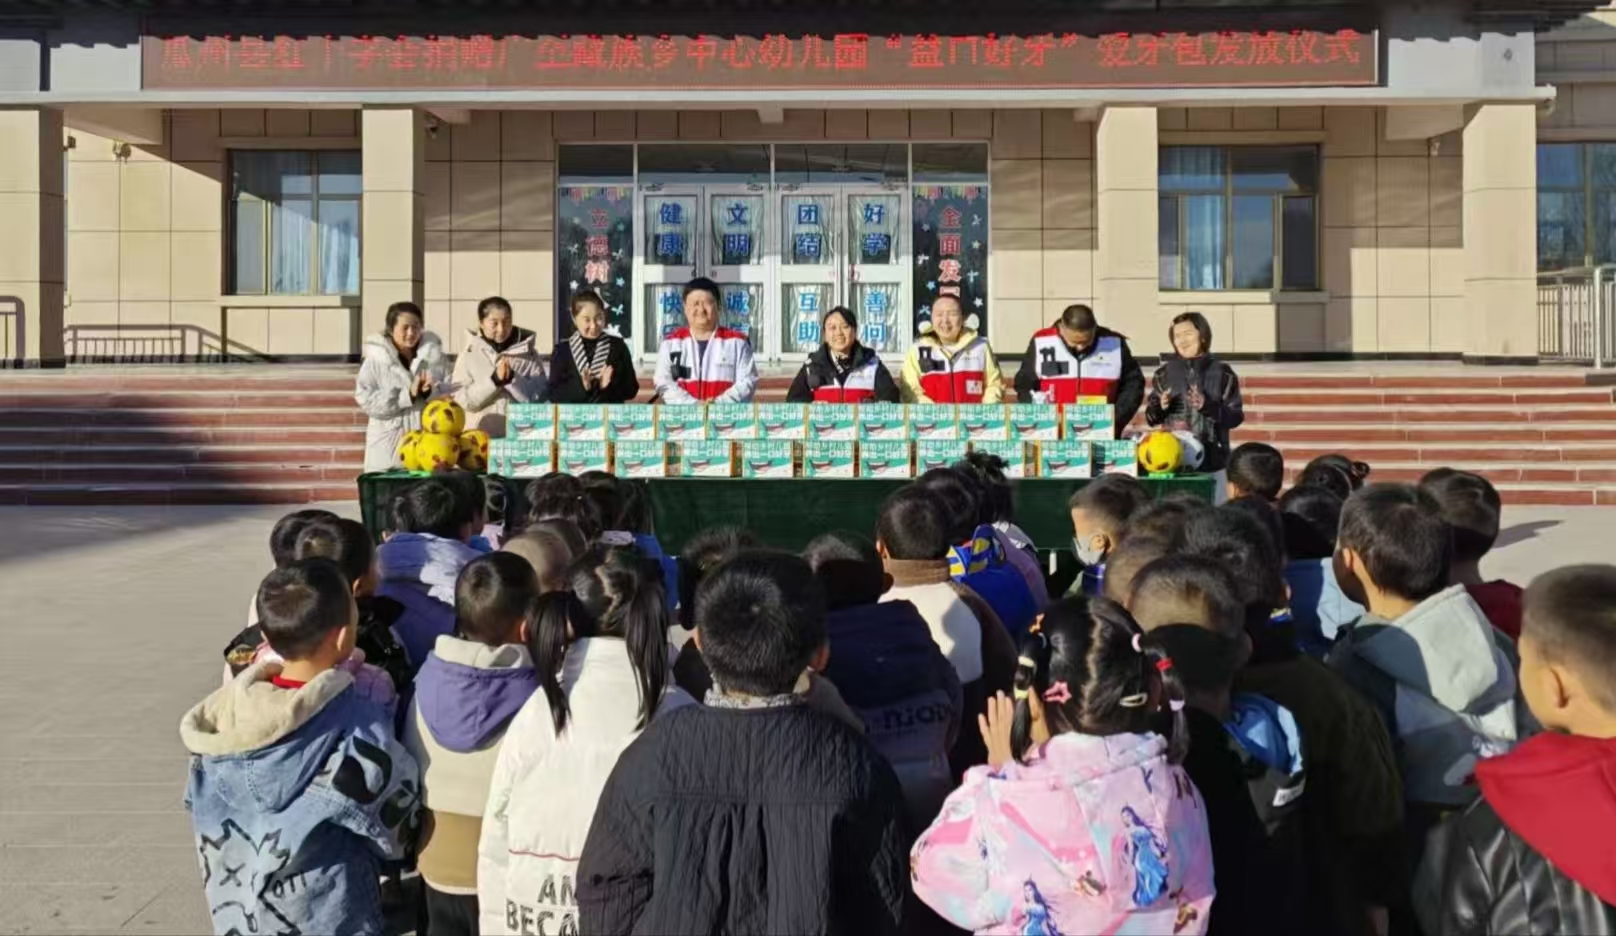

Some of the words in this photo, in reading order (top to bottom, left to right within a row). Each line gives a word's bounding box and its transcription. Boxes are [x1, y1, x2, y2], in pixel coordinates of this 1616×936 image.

[659, 202, 684, 256] 健康
[726, 203, 750, 256] 文明
[796, 204, 820, 256] 团结
[862, 203, 888, 256] 好学
[797, 292, 820, 344] 互助
[863, 292, 888, 344] 善问
